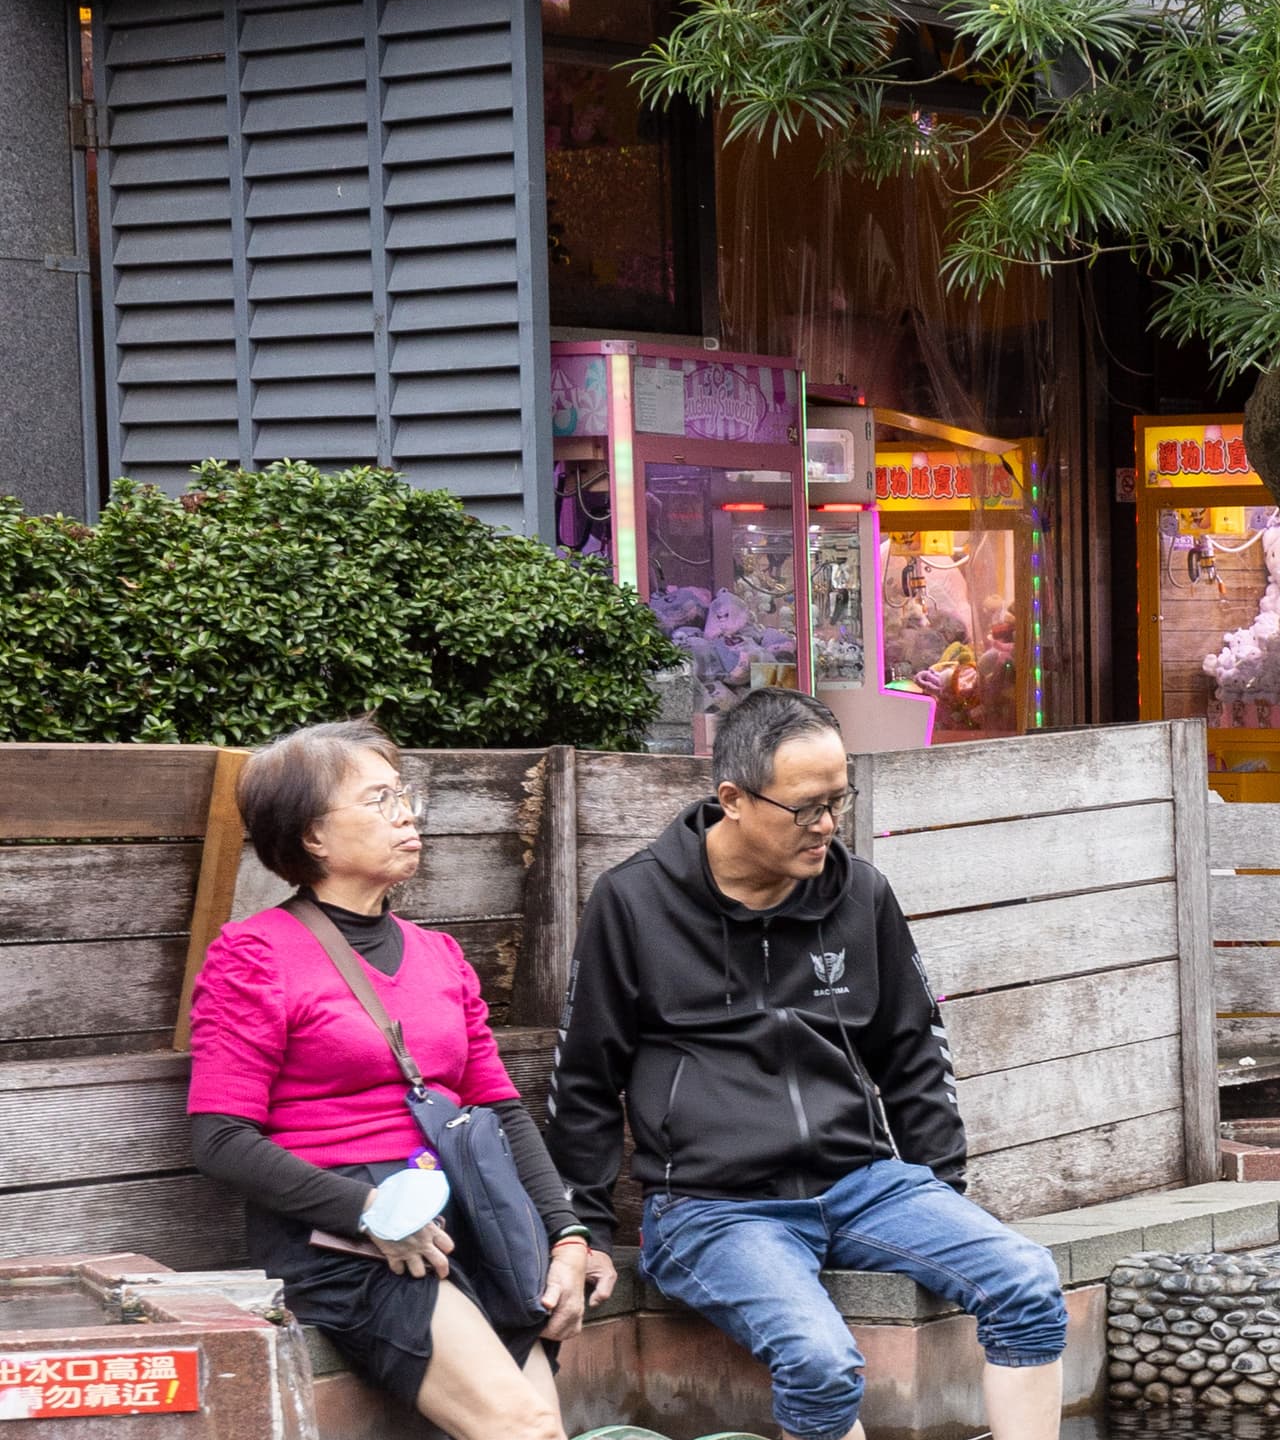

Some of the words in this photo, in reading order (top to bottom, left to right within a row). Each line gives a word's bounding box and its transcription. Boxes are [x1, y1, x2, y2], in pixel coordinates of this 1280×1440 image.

[0, 1356, 178, 1385] 出水口高溫
